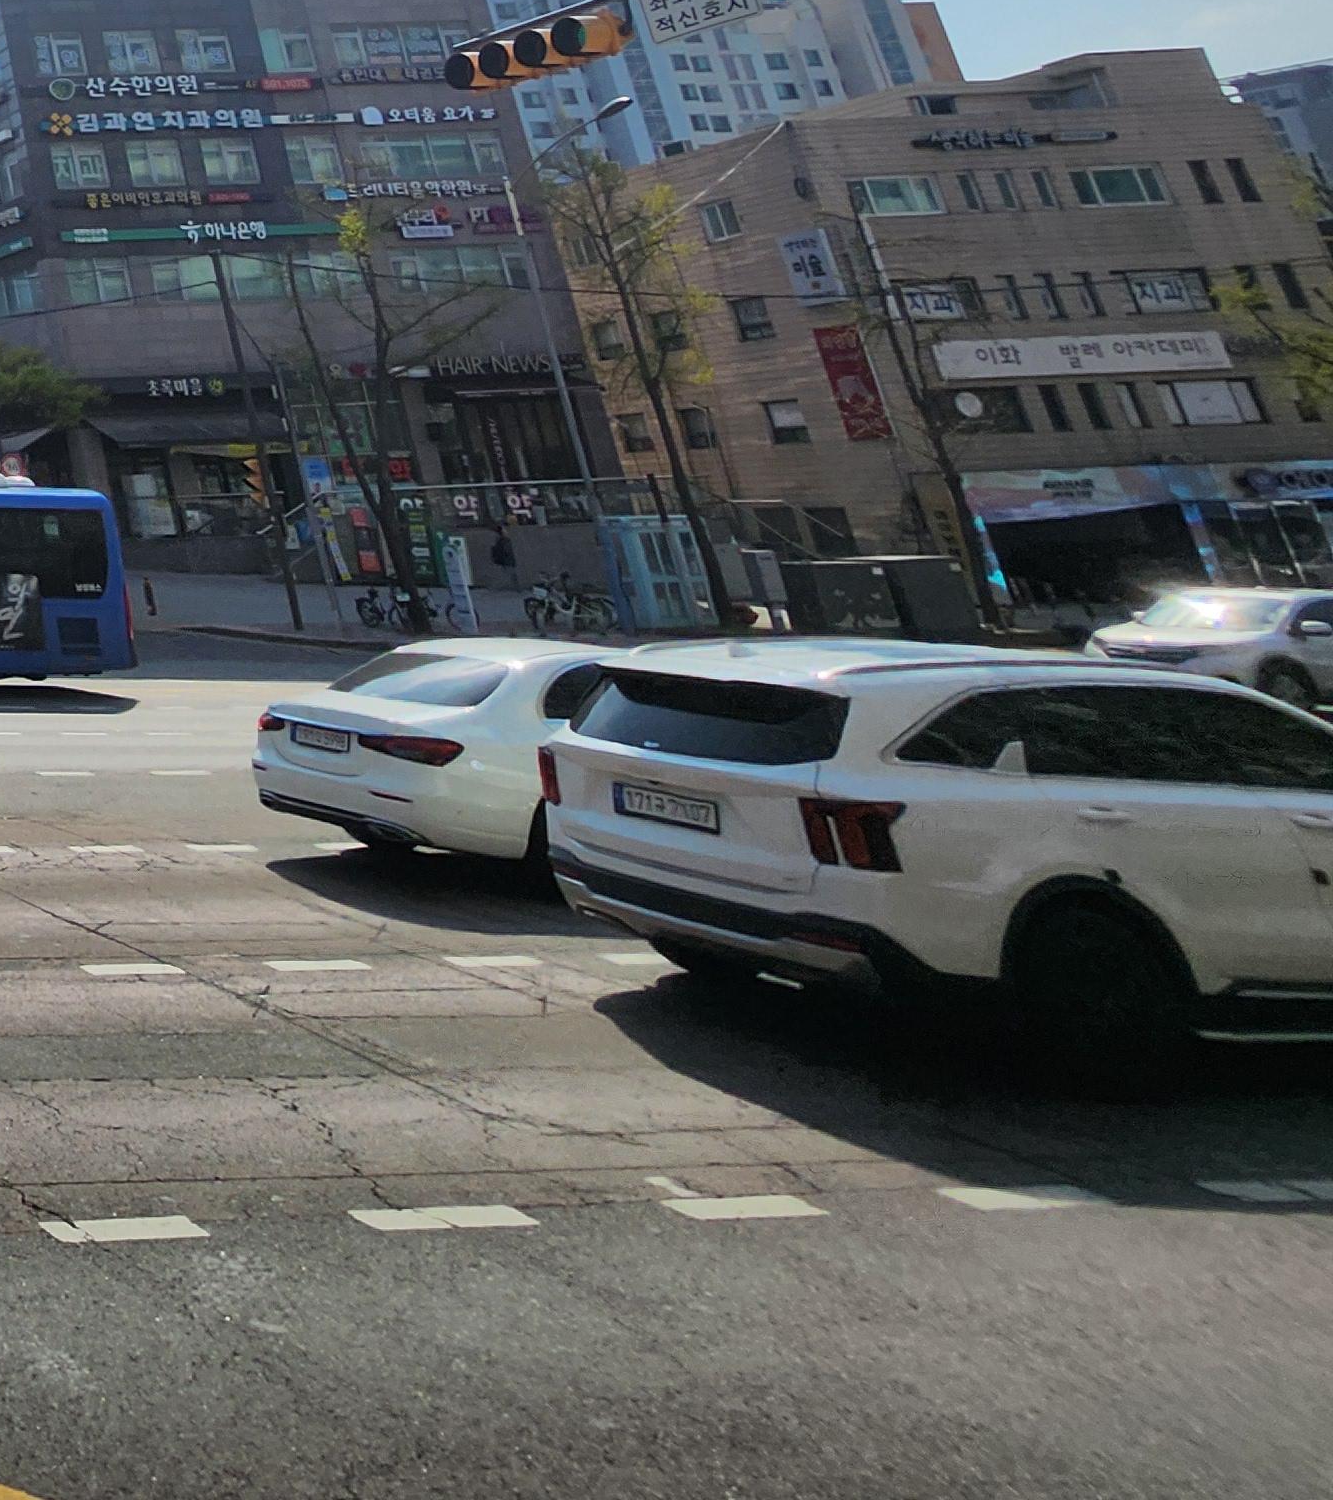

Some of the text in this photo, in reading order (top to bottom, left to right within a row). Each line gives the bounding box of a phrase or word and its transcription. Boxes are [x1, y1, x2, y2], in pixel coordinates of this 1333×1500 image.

[85, 74, 200, 98] 산수한의원
[75, 106, 264, 134] 김과연치과의원
[387, 108, 437, 125] 오티움
[442, 105, 475, 122] 요가
[204, 220, 267, 241] 하나은행
[975, 344, 1022, 365] 이화
[1059, 342, 1106, 369] 발레
[1112, 336, 1200, 358] 아카데미
[436, 353, 552, 376] HAIR NEWS
[148, 378, 204, 398] 초록마을
